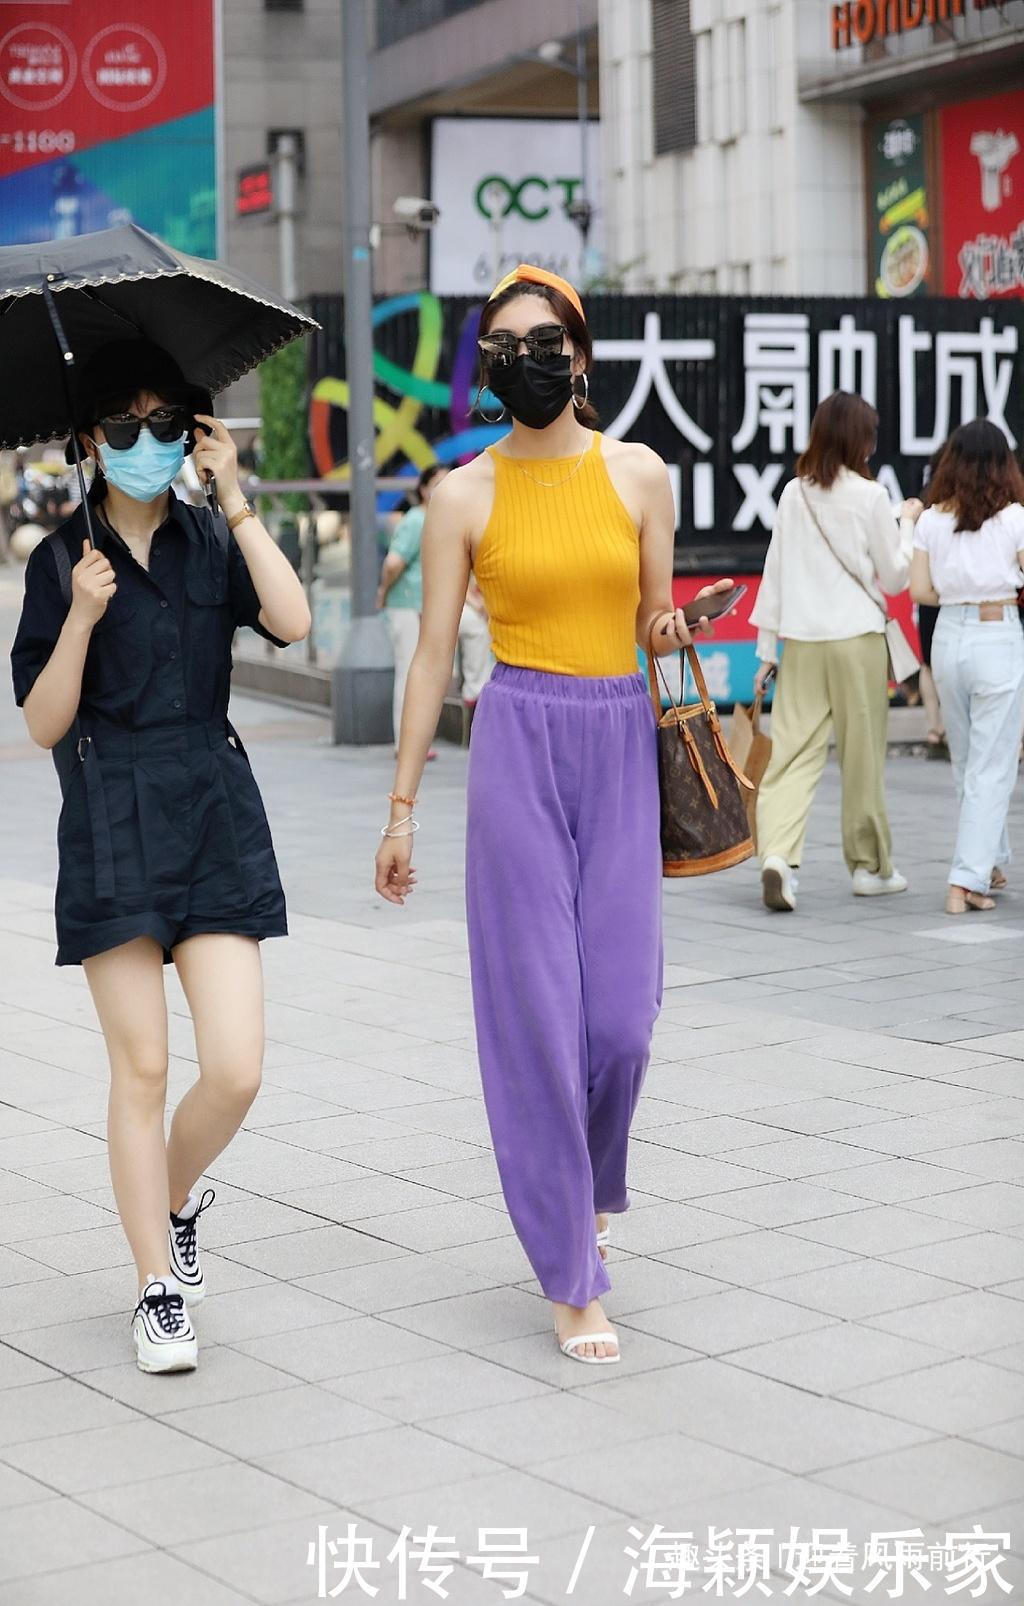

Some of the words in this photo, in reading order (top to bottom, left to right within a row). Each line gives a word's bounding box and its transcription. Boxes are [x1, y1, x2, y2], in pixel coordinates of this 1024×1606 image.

[475, 175, 582, 221] OCT
[591, 311, 1018, 456] 大融城
